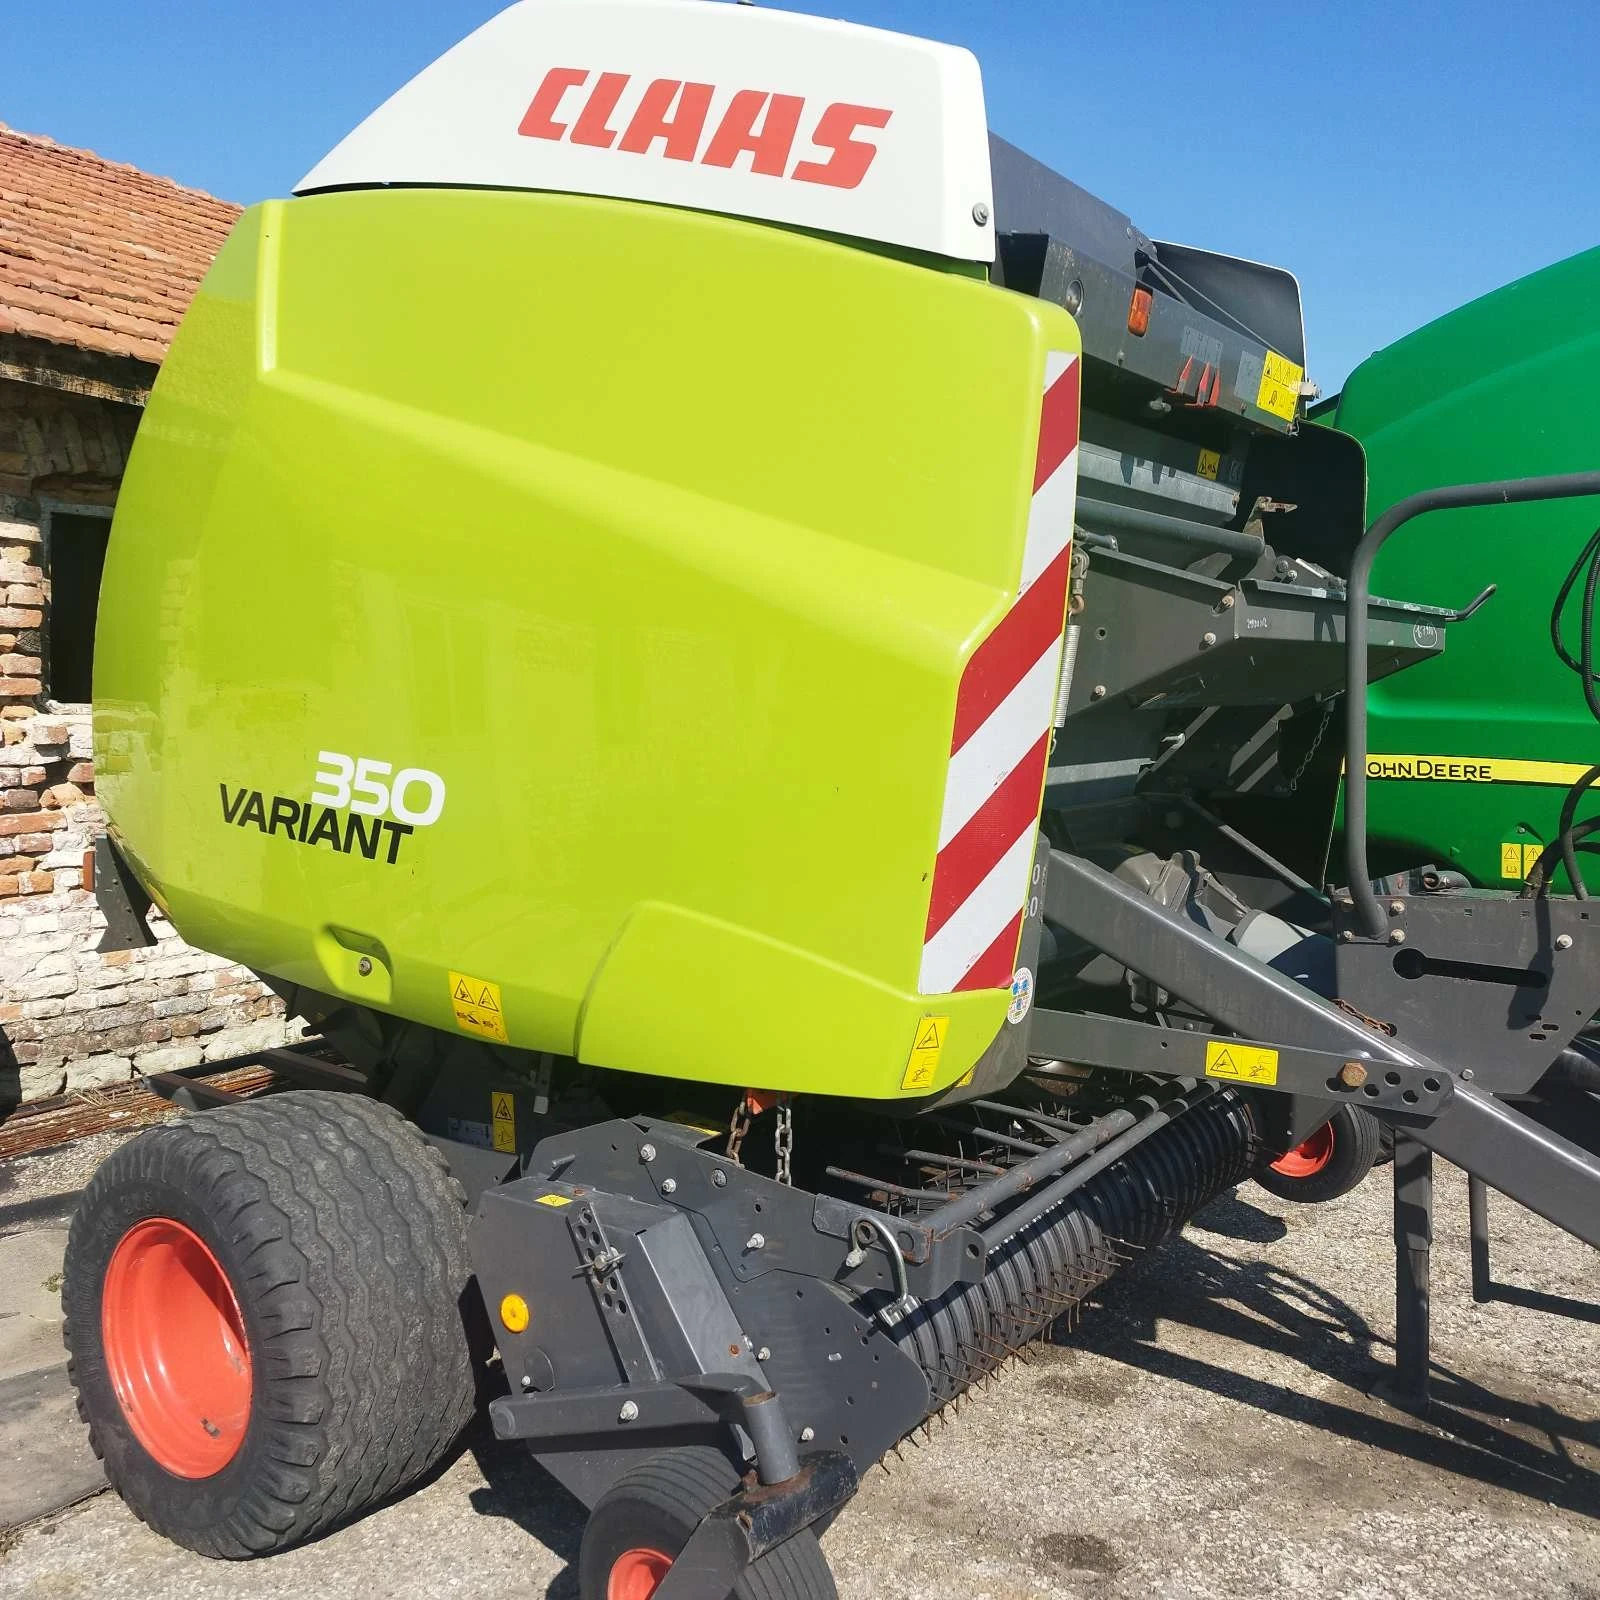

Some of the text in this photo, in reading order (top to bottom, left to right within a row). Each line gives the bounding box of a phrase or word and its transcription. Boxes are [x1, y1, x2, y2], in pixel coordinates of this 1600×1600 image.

[518, 67, 893, 189] CLAAS
[311, 750, 446, 826] 350
[1367, 760, 1492, 779] OHN DEERE
[219, 782, 414, 865] VARIANT
